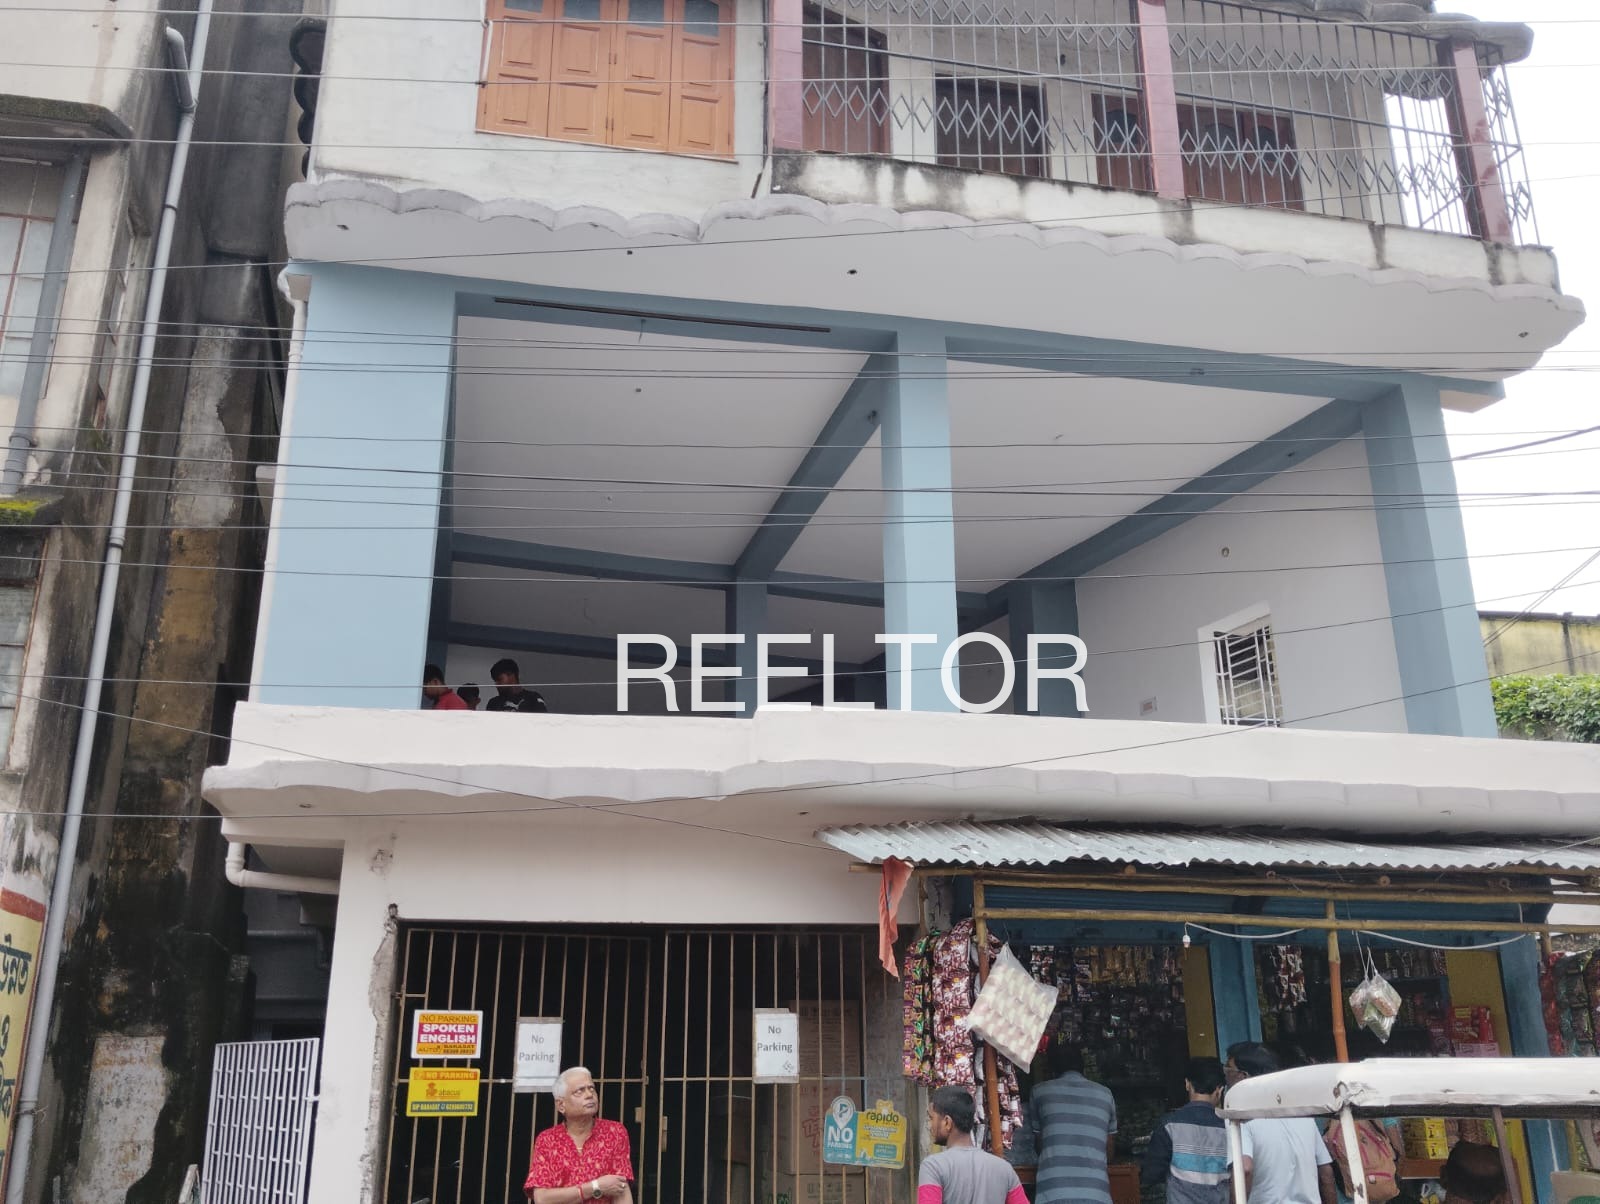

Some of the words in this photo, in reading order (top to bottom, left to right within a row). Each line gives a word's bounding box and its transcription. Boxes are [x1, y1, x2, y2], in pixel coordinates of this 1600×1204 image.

[422, 1014, 436, 1023] NO
[438, 1015, 477, 1023] PARKING
[422, 1023, 475, 1033] SPOKEN
[767, 1025, 782, 1034] No
[419, 1033, 476, 1043] ENGLISH
[531, 1034, 545, 1044] No
[757, 1042, 793, 1054] Parking
[518, 1051, 555, 1063] Parking
[426, 1071, 438, 1080] NO
[440, 1071, 475, 1080] PARKING
[438, 1087, 461, 1096] abacus
[866, 1112, 899, 1124] rapido
[827, 1126, 854, 1143] NO
